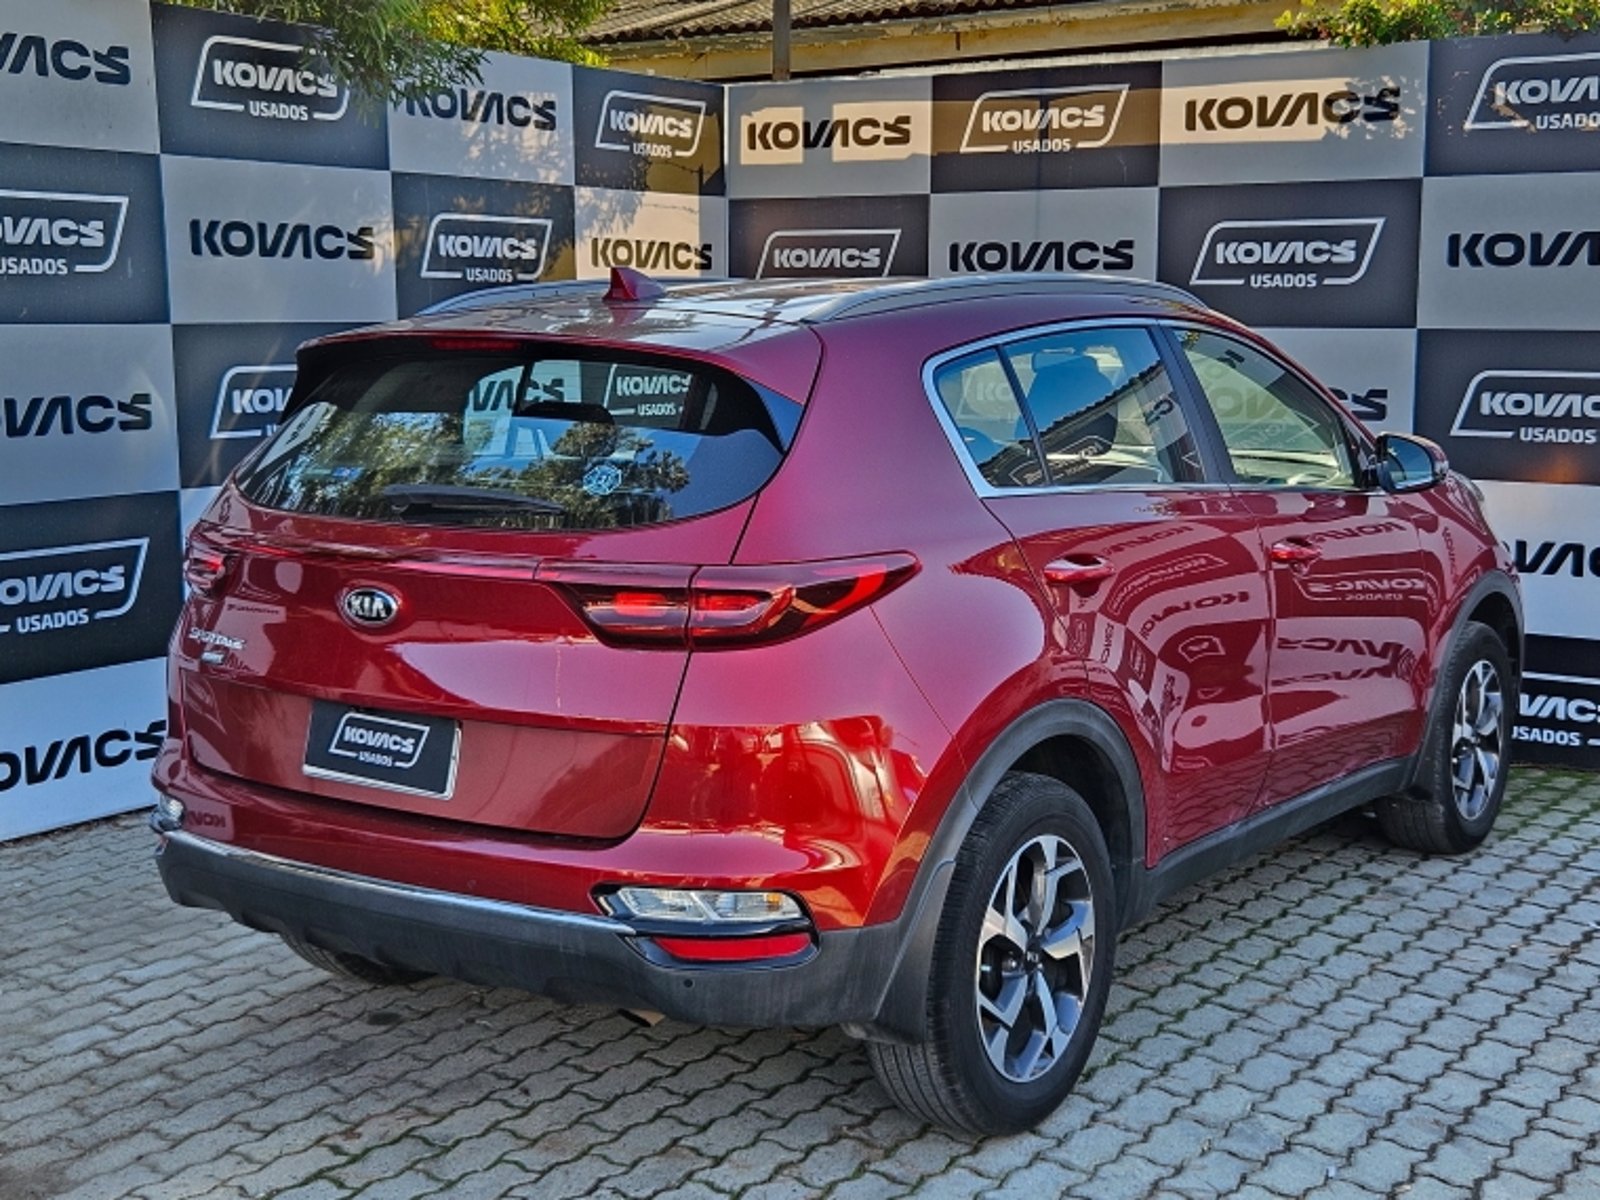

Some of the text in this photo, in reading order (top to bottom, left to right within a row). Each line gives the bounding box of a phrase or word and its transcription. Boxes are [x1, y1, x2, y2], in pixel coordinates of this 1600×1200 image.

[213, 58, 338, 98] KOVACS
[1494, 75, 1600, 105] KOVA
[248, 100, 309, 121] USADOS
[609, 108, 694, 138] KOVACS
[982, 105, 1106, 133] KOVACS
[1184, 86, 1401, 132] KOVACS
[747, 115, 912, 151] KOVACS
[1012, 137, 1072, 154] USADOS
[632, 142, 673, 158] USADOS
[0, 216, 105, 247] VACS
[189, 218, 375, 260] KOVACS
[438, 233, 537, 260] KOVACS
[591, 237, 713, 270] KOVACS
[773, 247, 881, 269] KOVACS
[950, 239, 1135, 272] KOVACS
[1216, 239, 1357, 265] KOVACS
[1447, 231, 1600, 268] KOVA
[466, 266, 514, 283] USADOS
[1250, 273, 1317, 289] USADOS
[0, 393, 152, 438] VACS
[1519, 427, 1597, 444] USADOS
[350, 594, 387, 618] KIA
[16, 608, 89, 633] USADOS
[1519, 692, 1600, 723] VAC
[344, 726, 416, 754] KOVACS
